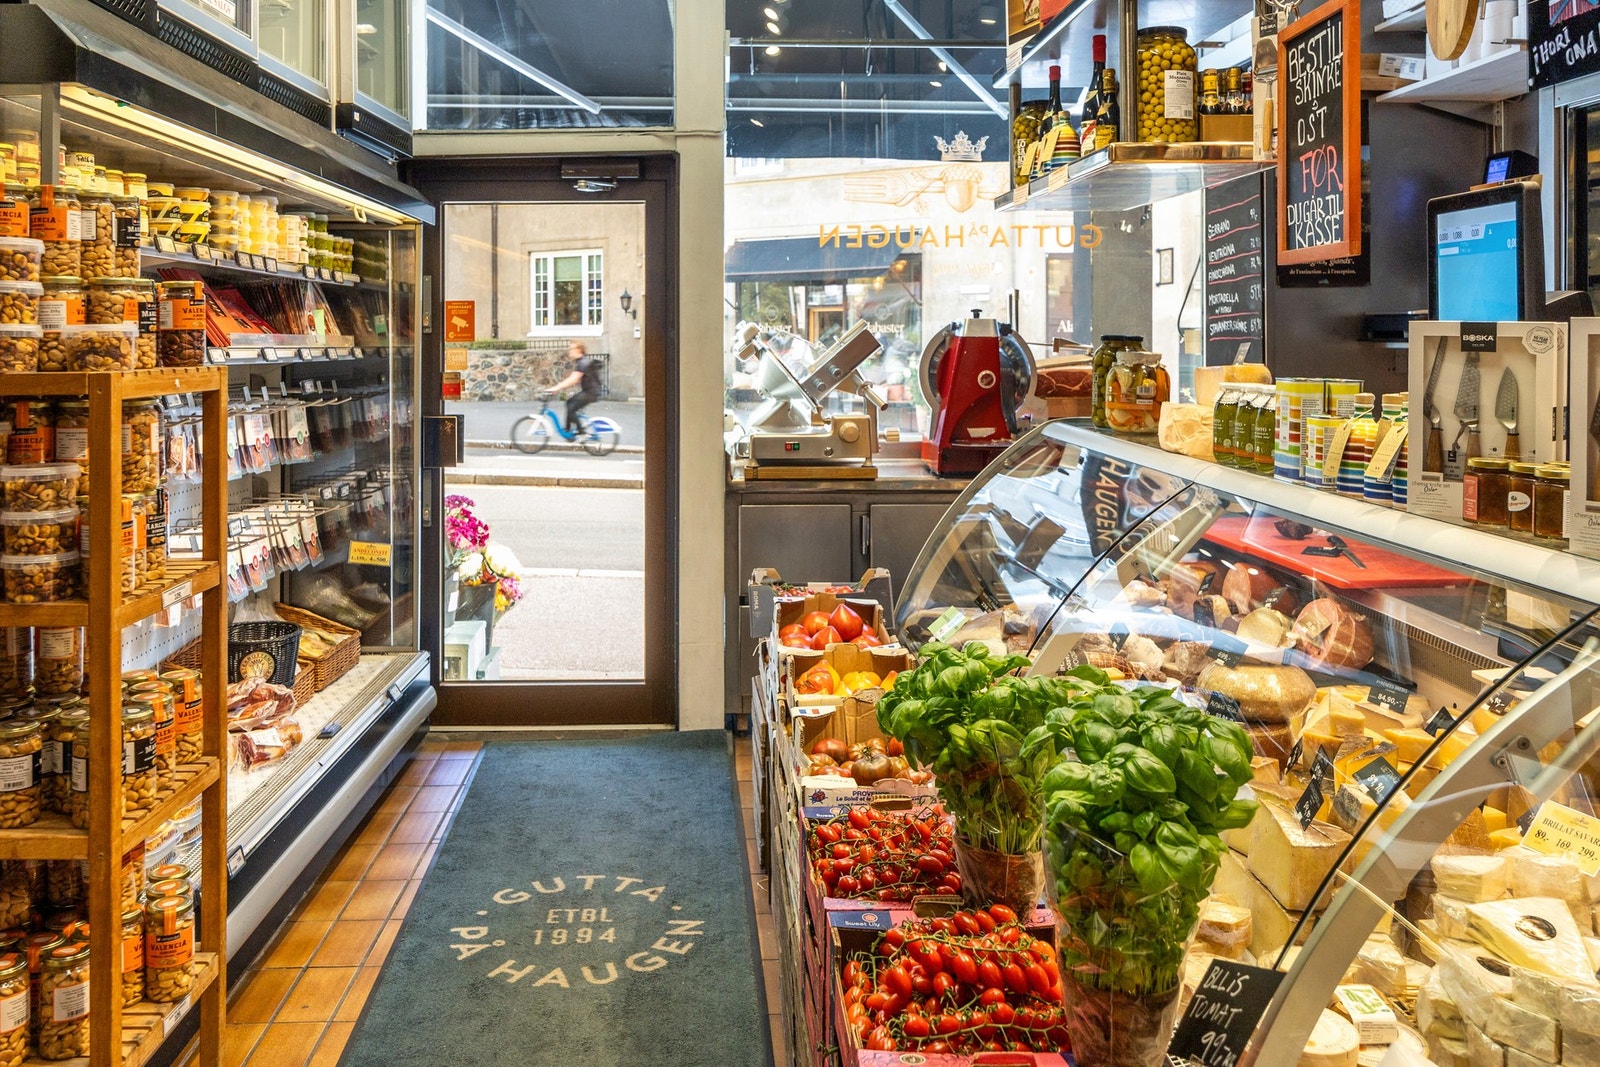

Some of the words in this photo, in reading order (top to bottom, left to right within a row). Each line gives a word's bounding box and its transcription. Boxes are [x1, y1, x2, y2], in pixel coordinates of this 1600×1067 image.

[1289, 20, 1344, 83] BESTILL
[1295, 59, 1342, 106] SKINKE
[1298, 106, 1328, 147] OST
[1300, 144, 1344, 195] FØR
[1295, 215, 1341, 250] KASSE
[867, 322, 905, 334] labaster
[1462, 334, 1494, 342] BOSKA
[1542, 817, 1575, 836] BRILLAT
[492, 874, 666, 904] GUTTA
[546, 908, 613, 924] ETBL
[867, 919, 881, 928] Lily
[150, 940, 187, 951] VALENCIA
[533, 927, 617, 945] 1994
[450, 925, 506, 960] PÅ
[487, 919, 705, 988] HAUGEN
[1189, 994, 1243, 1029] TOMAT
